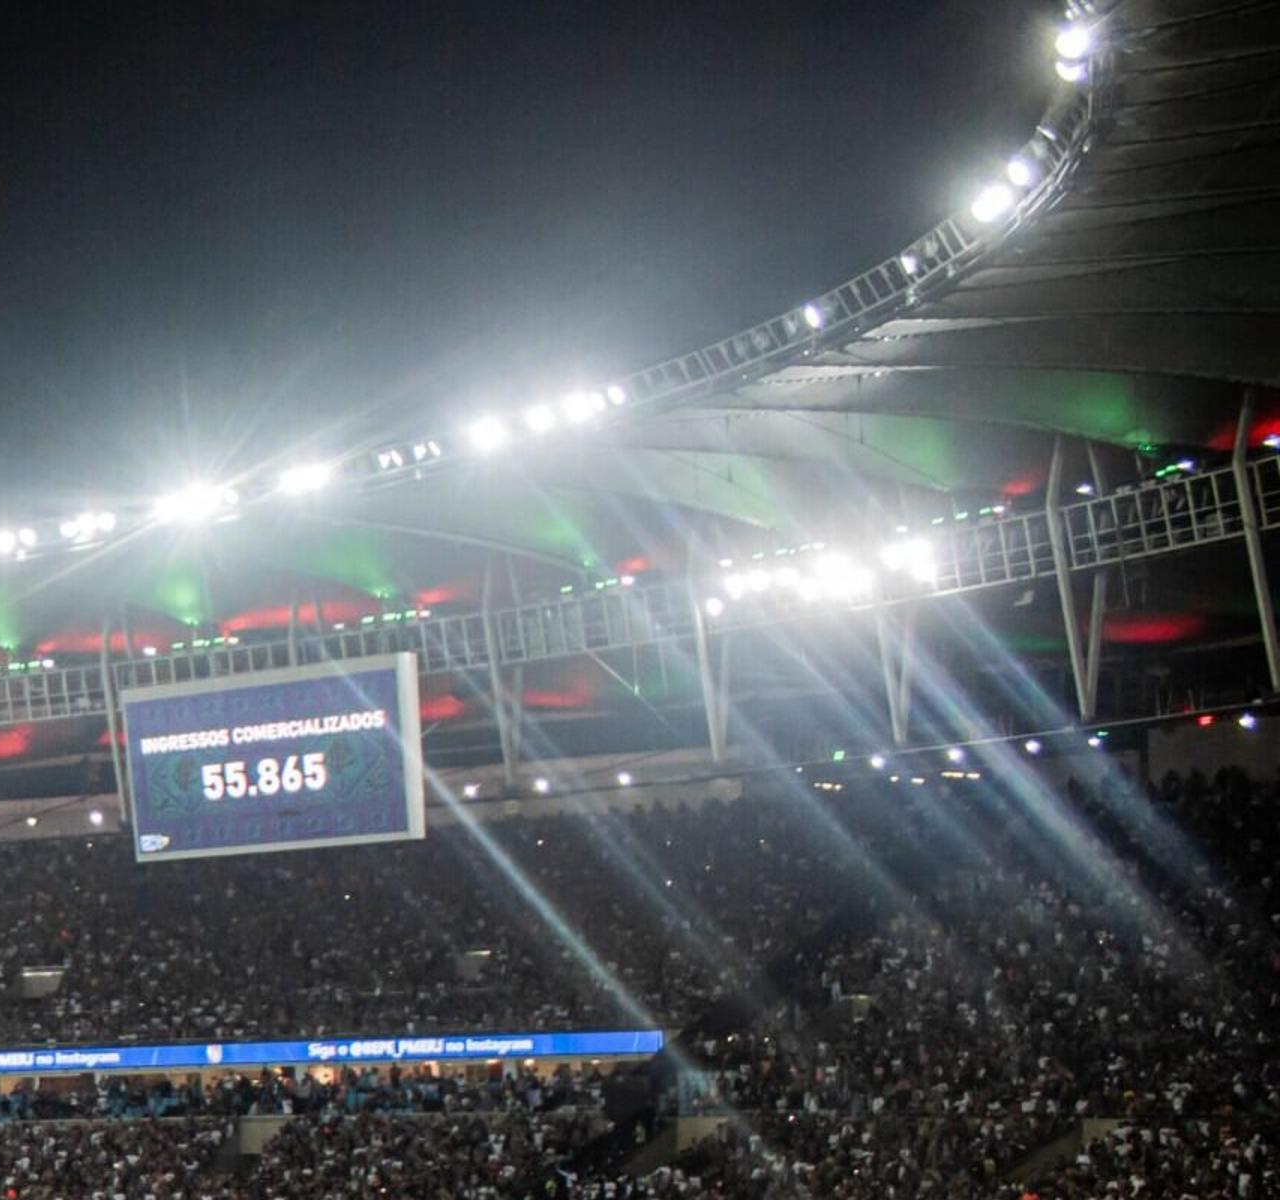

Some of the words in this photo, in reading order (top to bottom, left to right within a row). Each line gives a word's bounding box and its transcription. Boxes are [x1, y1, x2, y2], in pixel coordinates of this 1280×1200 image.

[140, 729, 230, 754] INGRESSOS
[232, 710, 386, 745] COMERCIALIZADOS
[201, 753, 327, 800] 55.865
